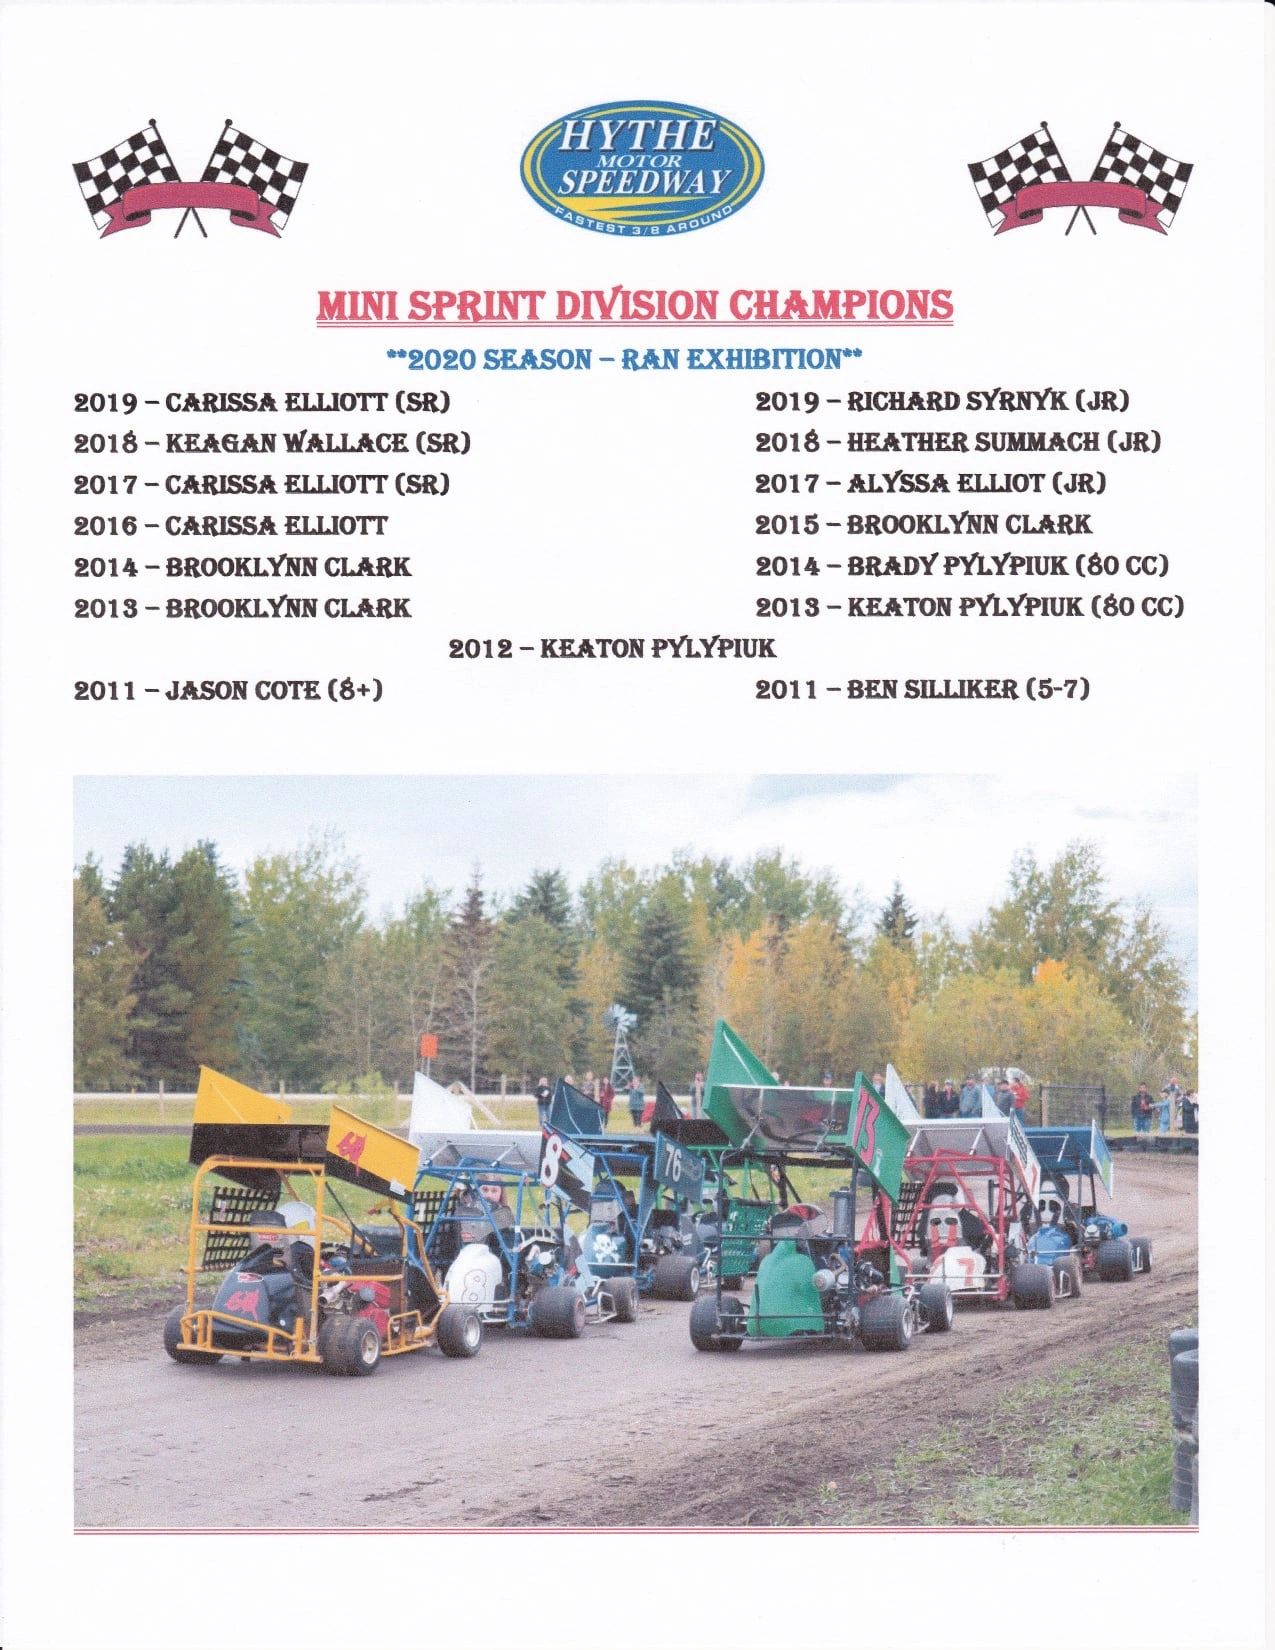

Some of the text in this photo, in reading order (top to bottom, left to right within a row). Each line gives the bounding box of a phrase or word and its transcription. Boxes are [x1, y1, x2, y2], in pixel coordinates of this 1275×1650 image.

[557, 119, 717, 151] HYTHE
[595, 154, 683, 168] MOTOR
[558, 169, 732, 195] SPEEDWAY
[554, 206, 626, 234] FASTEST
[666, 205, 733, 234] AROUND
[316, 285, 954, 321] MINI SPRINT DIVISION CHAMPIONS
[483, 349, 592, 370] SEASON
[622, 349, 680, 371] RAN
[75, 393, 137, 415] 2019
[166, 393, 278, 413] CARISSA
[285, 393, 389, 412] ELLIOTT
[396, 391, 450, 414] (SR)
[756, 392, 819, 414] 2019
[847, 391, 960, 412] RICHARD
[966, 387, 1069, 412] SYRNYK
[1076, 389, 1129, 412] (JR)
[75, 430, 138, 453] 2018
[166, 434, 277, 453] KEAGAN
[283, 429, 409, 453] WALLACE
[416, 431, 470, 455] (SR)
[756, 429, 819, 452] 2018
[847, 432, 969, 453] HEATHER
[975, 432, 1100, 452] SUMMACH
[1108, 430, 1161, 453] (JR)
[74, 475, 137, 494] 2017
[166, 475, 278, 495] CARISSA
[284, 475, 388, 494] ELLIOTT
[395, 473, 449, 496] (SR)
[756, 474, 819, 493] 2017
[847, 470, 950, 493] ALYSSA
[957, 474, 1046, 493] ELLIOT
[1053, 471, 1106, 495] (JR)
[74, 516, 137, 536] 2016
[166, 516, 278, 537] CARISSA
[284, 516, 389, 535] ELLIOTT
[756, 513, 819, 535] 2015
[847, 510, 999, 536] BROOKLYNN
[1006, 514, 1093, 535] CLARK
[75, 558, 138, 577] 2014
[166, 553, 318, 578] BROOKLYNN
[325, 557, 412, 578] CLARK
[756, 556, 820, 576] 2014
[848, 552, 939, 577] BRADY
[943, 552, 1069, 575] PYLYPIUK
[1076, 552, 1119, 577] (80
[1126, 554, 1168, 577] CC)
[75, 599, 137, 618] 2013
[166, 594, 318, 619] BROOKLYNN
[324, 598, 412, 619] CLARK
[756, 598, 819, 617] 2013
[848, 598, 952, 617] KEATON
[959, 593, 1085, 616] PYLYPIUK
[1092, 593, 1134, 619] (80
[1142, 595, 1184, 618] CC)
[449, 639, 512, 659] 2012
[541, 639, 645, 658] KEATON
[651, 635, 777, 658] PYLYPIUK
[75, 681, 134, 700] 2011
[165, 681, 248, 700] JASON
[255, 681, 321, 700] COTE
[328, 677, 382, 702] (8+)
[756, 680, 816, 699] 2011
[847, 680, 898, 699] BEN
[904, 679, 1019, 700] SILLIKER
[1027, 677, 1089, 701] (5-7)
[852, 1087, 880, 1167] 13
[541, 1134, 562, 1188] 8
[665, 1142, 682, 1182] 76
[956, 1257, 975, 1286] 7
[462, 1268, 487, 1308] 8
